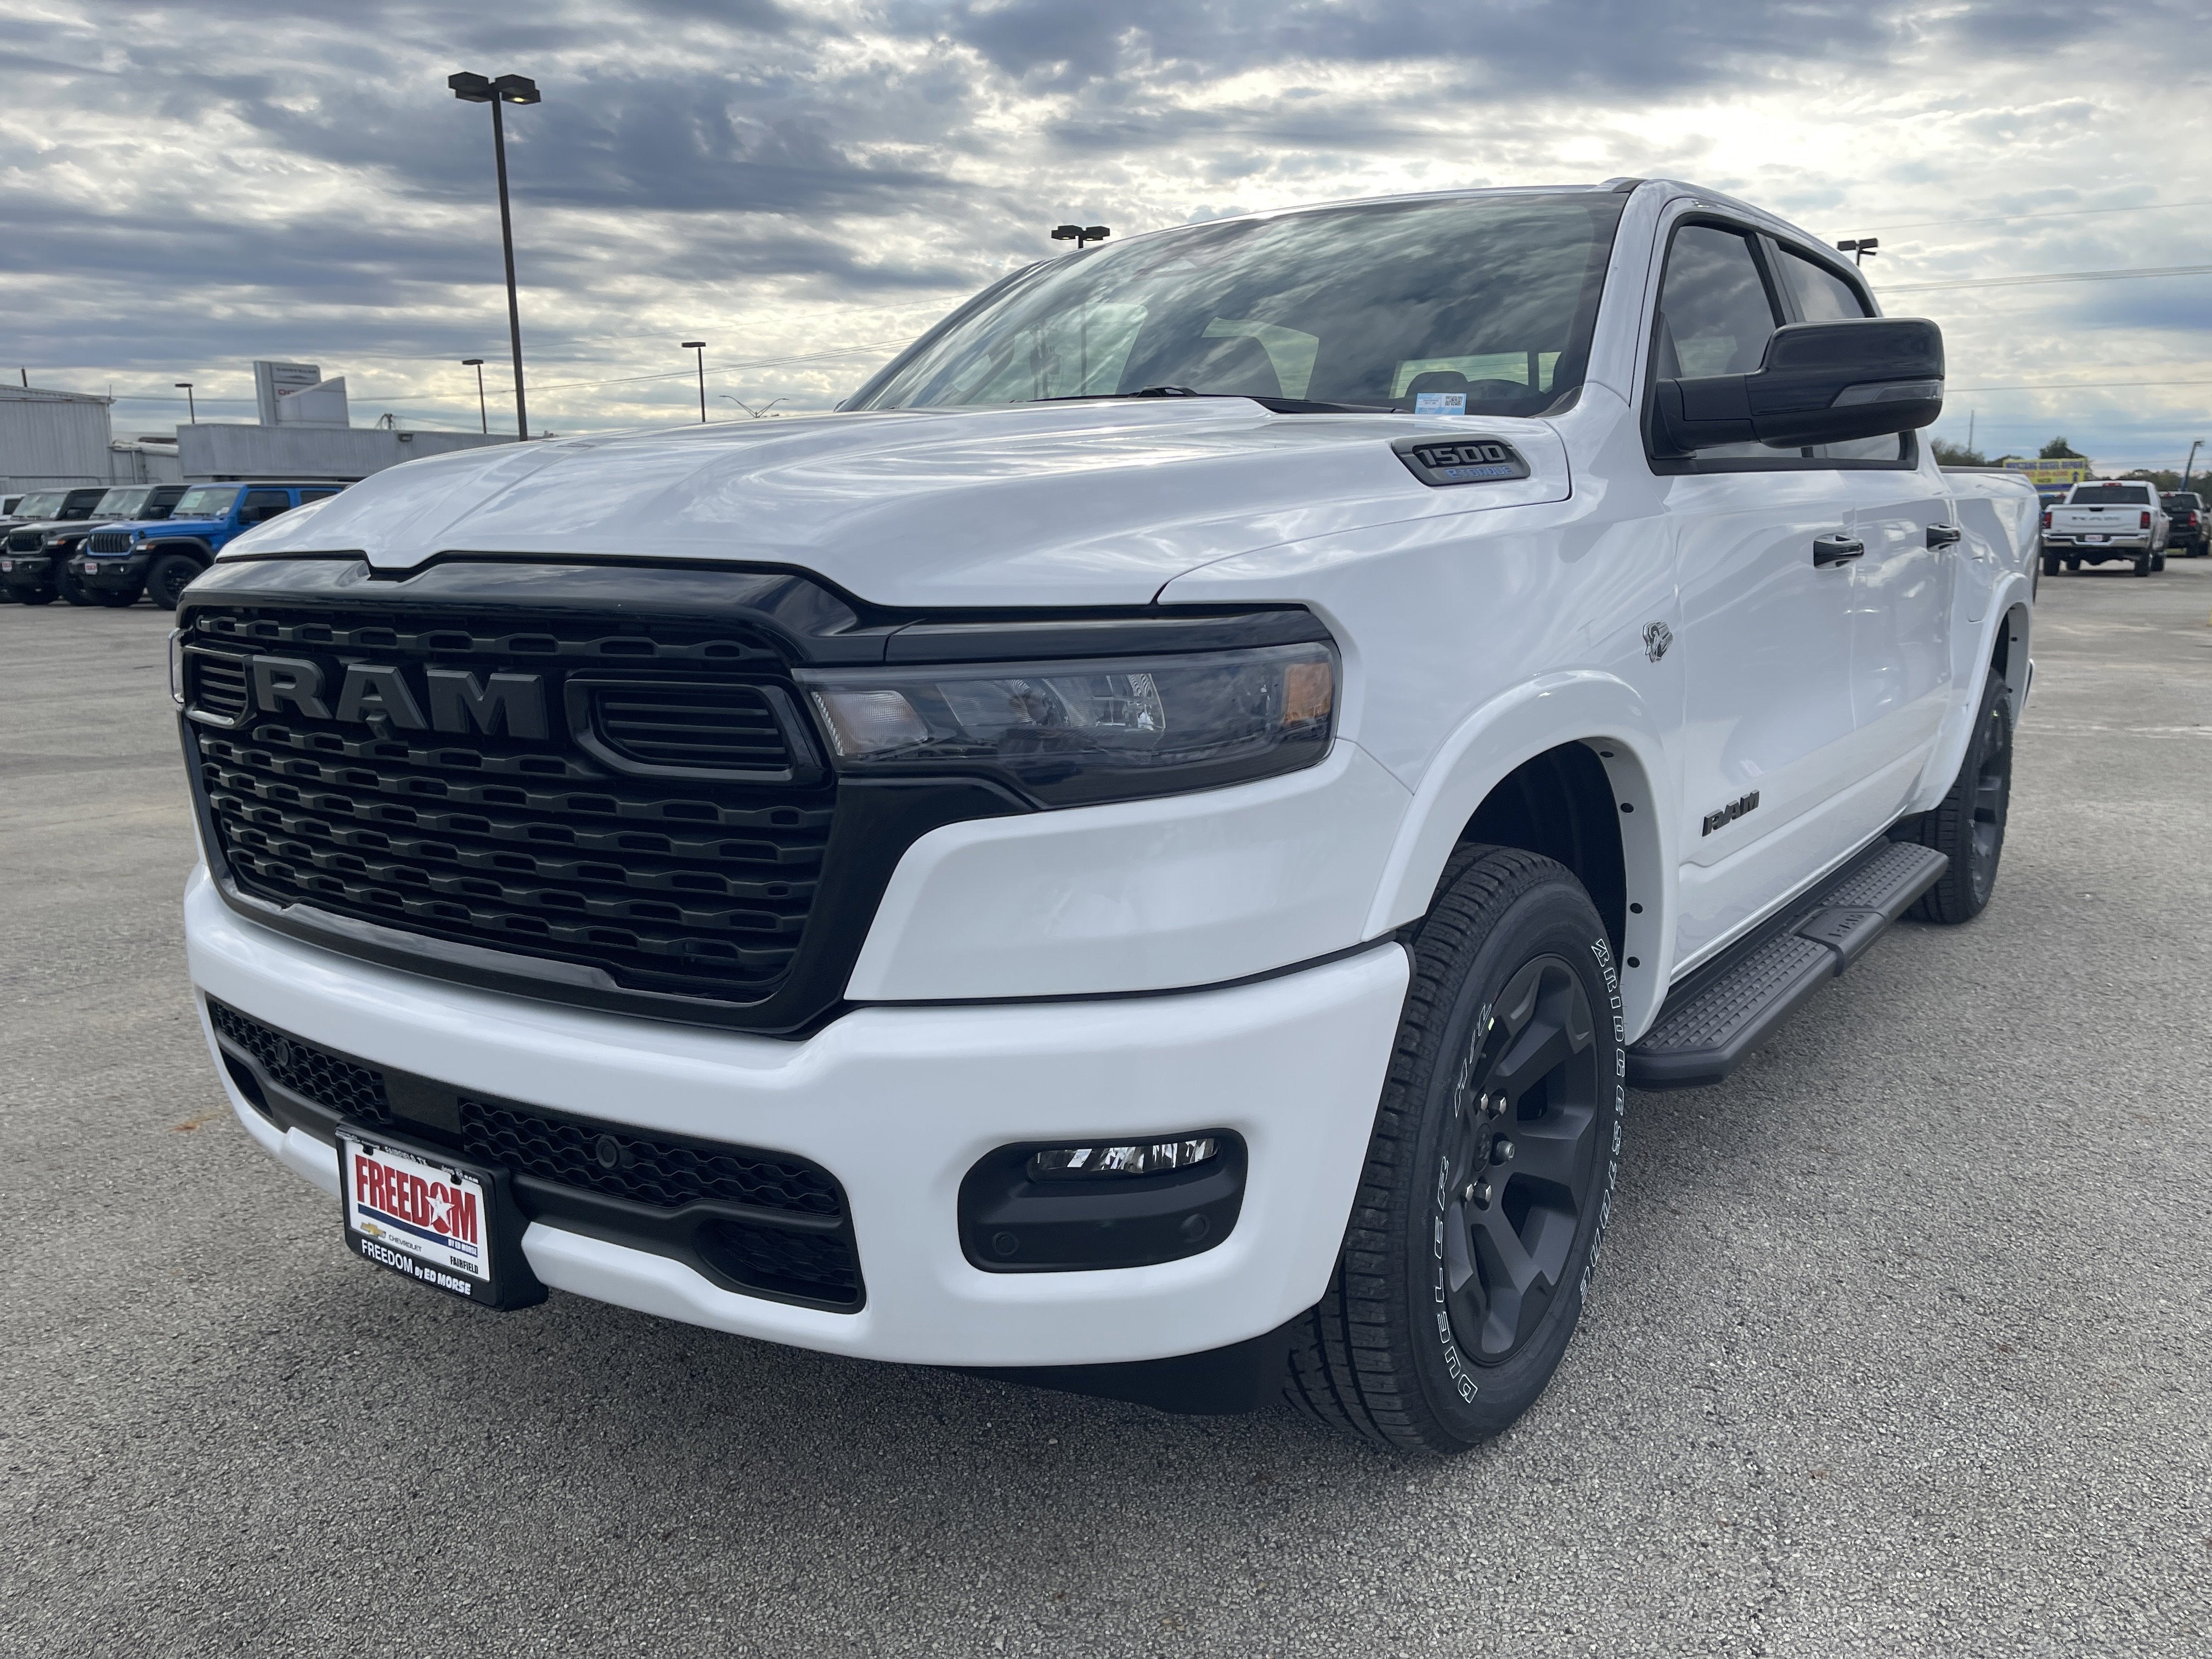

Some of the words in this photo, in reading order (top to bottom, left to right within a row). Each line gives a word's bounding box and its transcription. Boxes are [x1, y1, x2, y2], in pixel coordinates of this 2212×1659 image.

[1418, 444, 1506, 466] 1500
[253, 654, 548, 740] RAM
[1702, 789, 1760, 837] RAM
[355, 1154, 478, 1244] FREEDOM
[361, 1239, 413, 1274] FREEDOM
[424, 1267, 437, 1283] ED
[437, 1272, 471, 1296] MORSE
[388, 1234, 422, 1252] CHEVROLET
[450, 1255, 479, 1274] FAIRFIELD
[1434, 1155, 1479, 1404] DUELER
